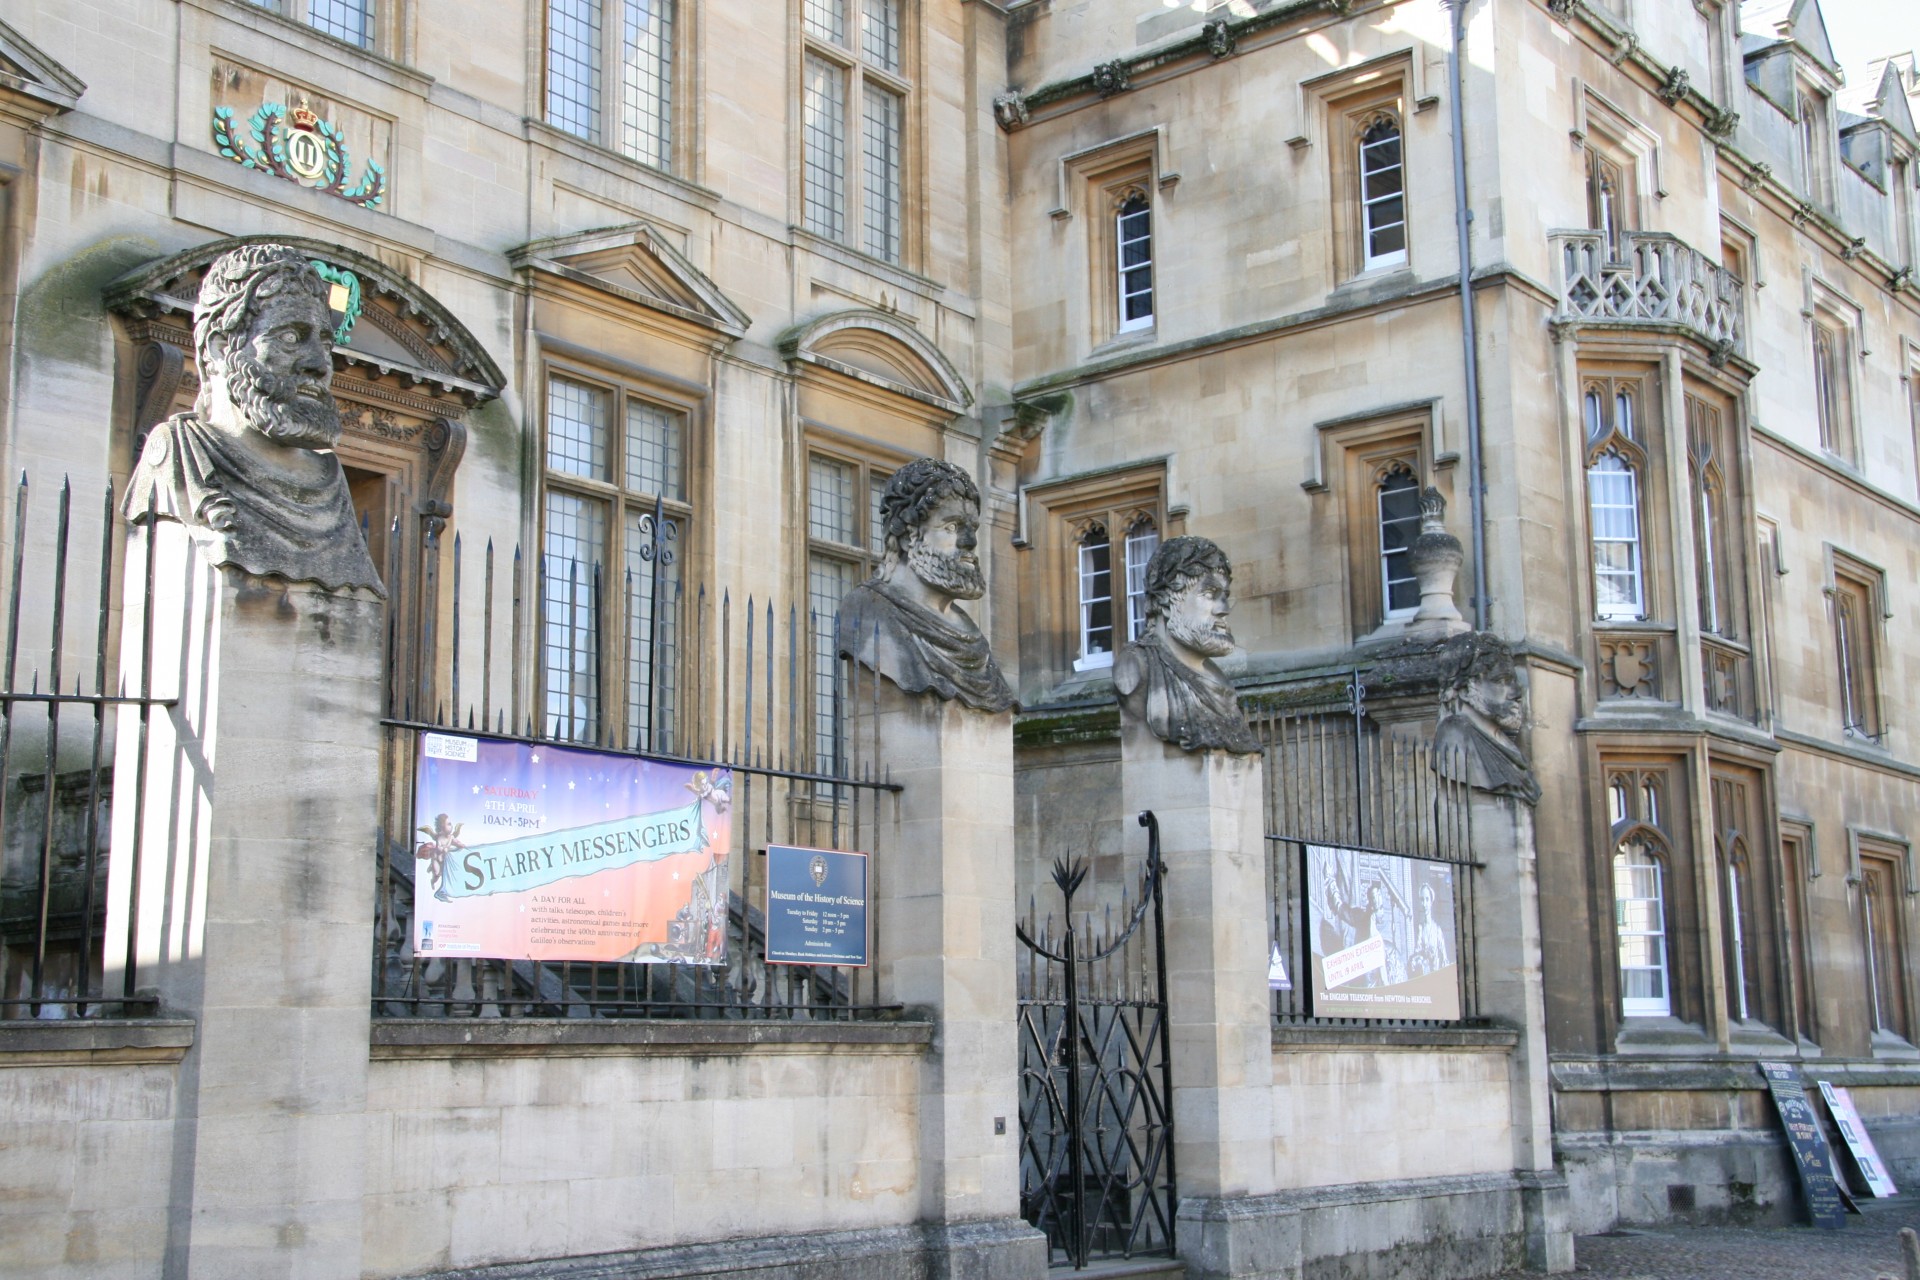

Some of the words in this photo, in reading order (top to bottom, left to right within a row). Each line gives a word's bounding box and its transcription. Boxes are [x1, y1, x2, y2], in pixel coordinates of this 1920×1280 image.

[484, 785, 538, 799] SATURDAY
[484, 800, 505, 810] 4TH
[508, 803, 538, 814] APRIL
[483, 814, 540, 828] 10AM-5PM
[463, 846, 555, 891] STARRY
[560, 818, 691, 866] MESSENGERS
[770, 890, 796, 900] Museum
[796, 892, 804, 901] of
[804, 893, 814, 902] the
[814, 894, 835, 906] History
[836, 896, 843, 904] of
[844, 896, 864, 906] Science
[786, 908, 802, 916] Tuesday
[530, 927, 566, 935] celebrating
[1326, 950, 1355, 969] EXHIBITION
[1356, 940, 1382, 956] EXTENDED
[1328, 970, 1344, 982] UNTIL
[1350, 960, 1364, 973] APRIL
[1320, 992, 1328, 1000] The
[1329, 992, 1349, 1001] ENGLISH
[1350, 994, 1374, 1002] TELESCOPE
[1374, 994, 1384, 1002] from
[1384, 994, 1405, 1003] NEWTON
